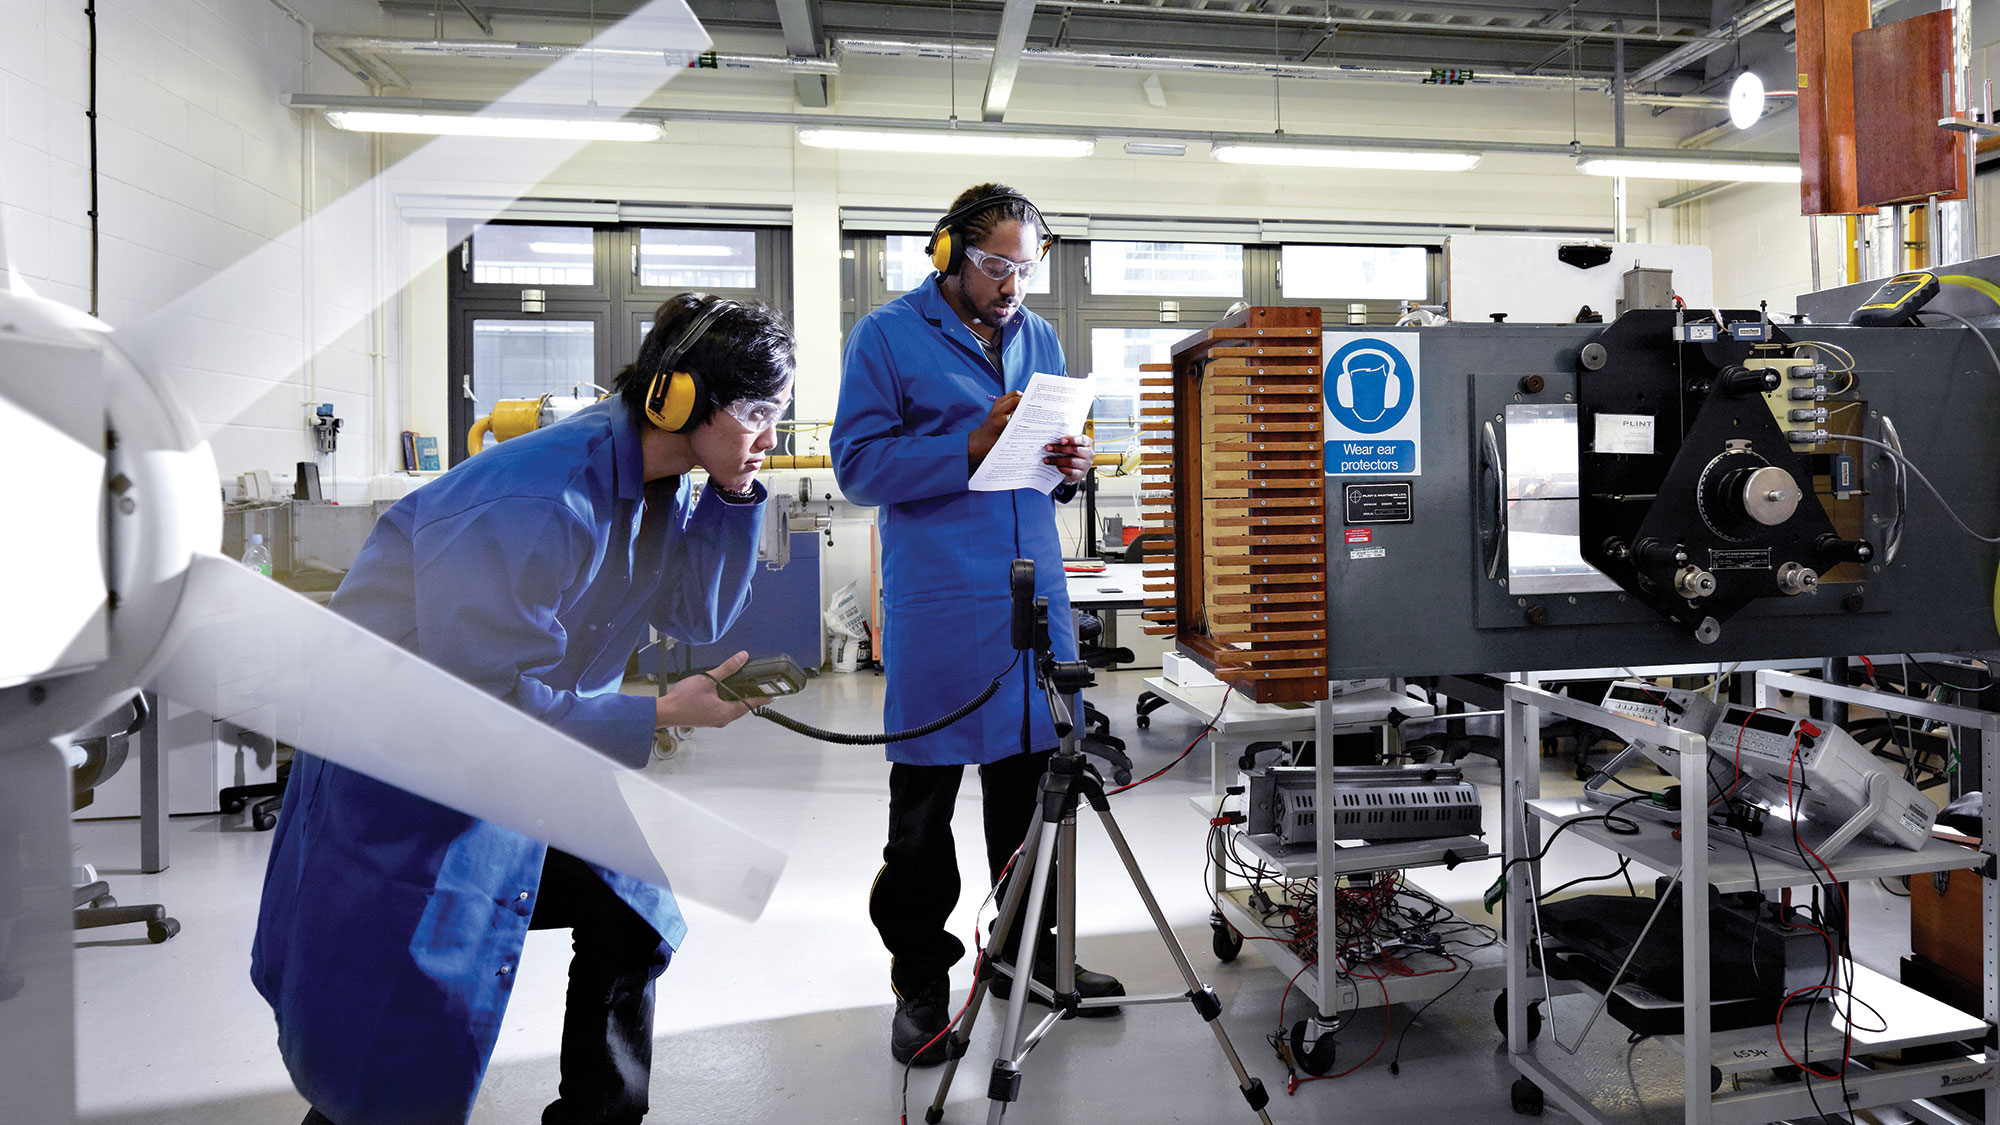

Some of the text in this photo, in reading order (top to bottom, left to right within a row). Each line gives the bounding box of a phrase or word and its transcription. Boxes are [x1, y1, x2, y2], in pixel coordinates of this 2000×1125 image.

[1343, 443, 1397, 456] Wear ear
[1341, 459, 1399, 472] protectors
